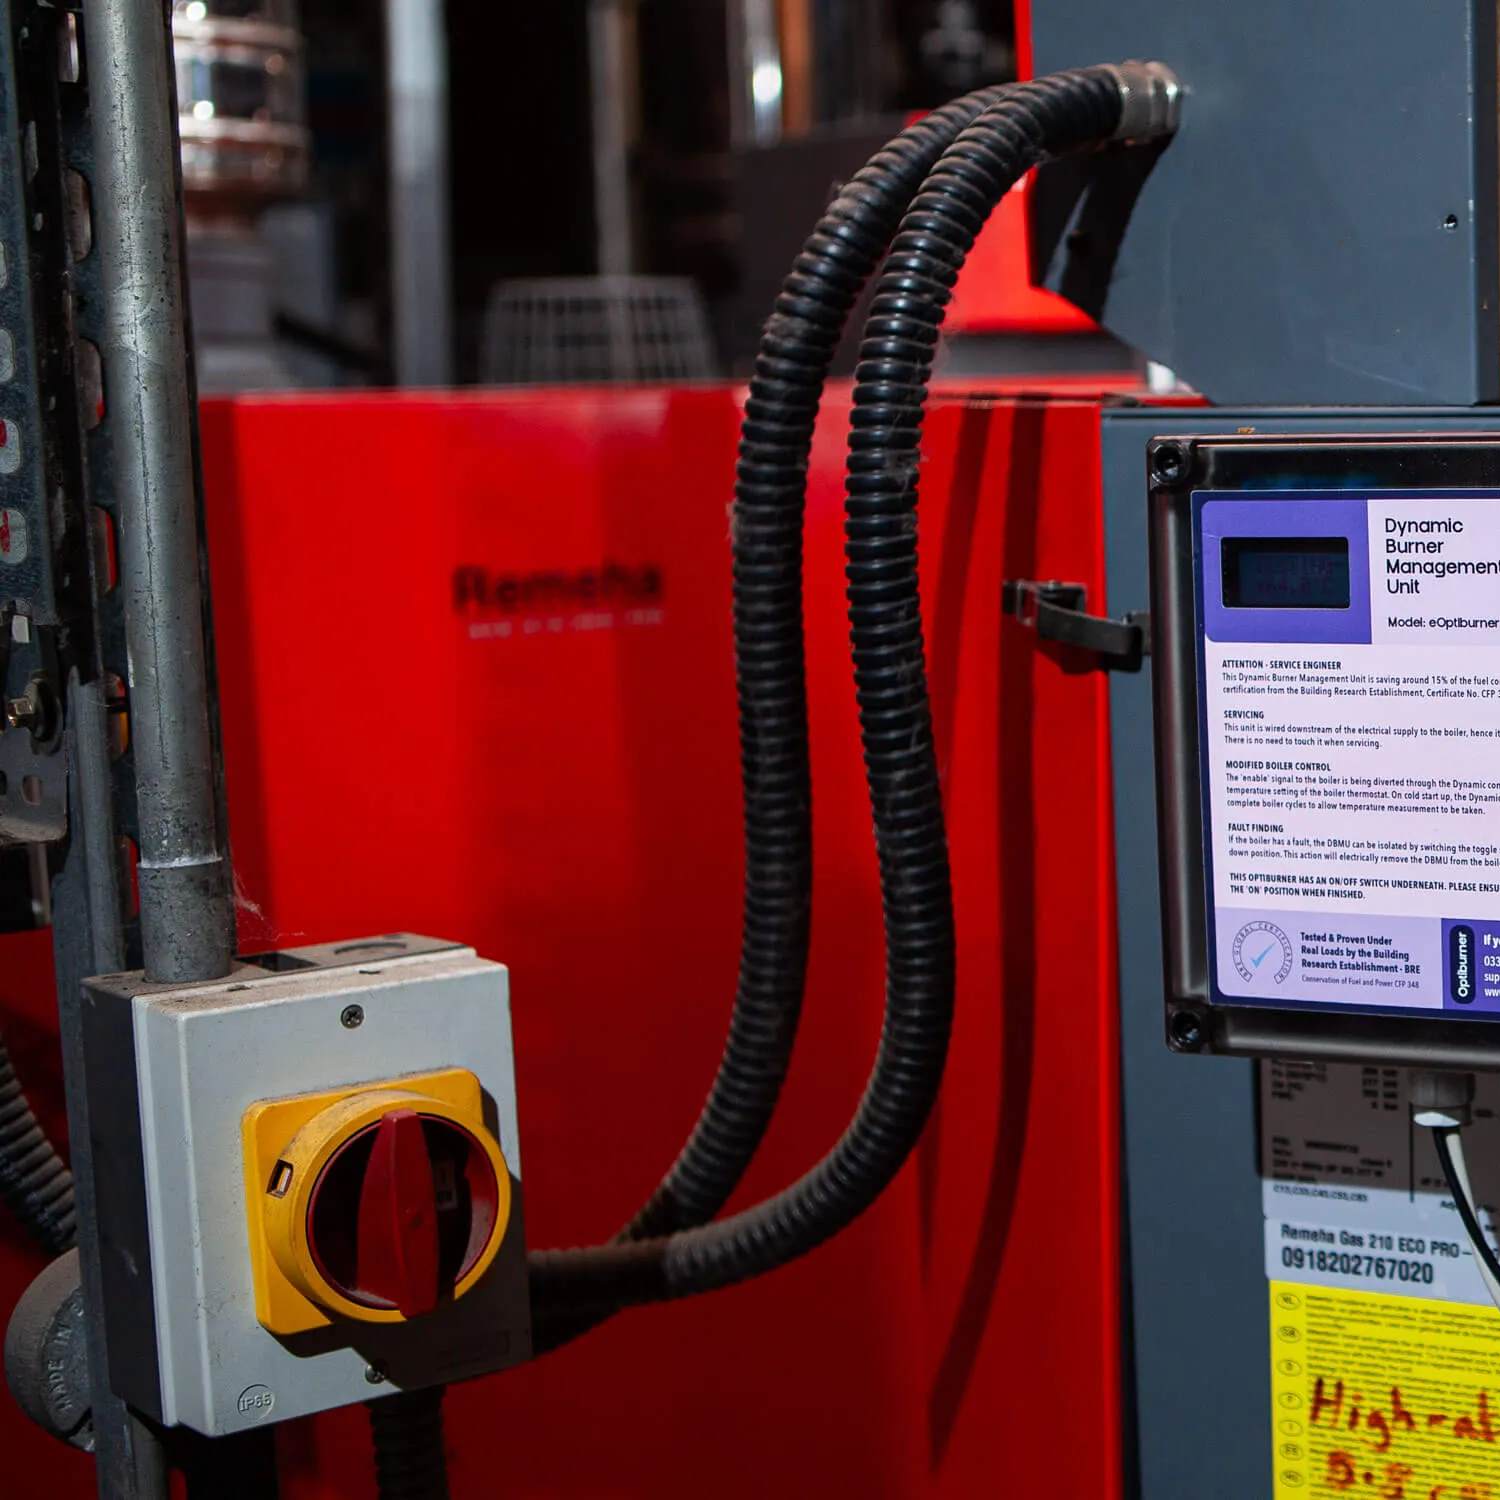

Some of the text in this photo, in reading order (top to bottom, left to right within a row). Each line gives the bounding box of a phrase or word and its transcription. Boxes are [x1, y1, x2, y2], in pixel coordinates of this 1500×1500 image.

[1384, 518, 1463, 537] Dynamic
[1385, 538, 1444, 553] Burner
[1386, 579, 1420, 594] Unit
[1387, 617, 1500, 629] Model: eOptiburner
[1221, 659, 1263, 668] ATTENTION
[1269, 660, 1301, 669] SERVICE
[1302, 661, 1342, 670] ENGINEER
[1222, 672, 1237, 681] This
[1238, 672, 1270, 683] Dynamic
[1272, 673, 1297, 682] Burner
[1298, 673, 1348, 684] Management
[1350, 674, 1366, 683] Unit
[1367, 675, 1374, 683] is
[1375, 677, 1400, 686] saving
[1402, 675, 1429, 684] around
[1431, 675, 1448, 684] 15%
[1449, 675, 1458, 685] of
[1458, 676, 1472, 685] the
[1473, 675, 1489, 685] fuel
[1222, 684, 1266, 693] certification
[1266, 685, 1285, 694] from
[1286, 686, 1299, 694] the
[1300, 686, 1332, 697] Building
[1334, 686, 1367, 695] Research
[1368, 687, 1425, 697] Establishment,
[1426, 688, 1464, 697] Certificate
[1466, 689, 1480, 698] No.
[1481, 689, 1496, 698] CFP
[1223, 710, 1264, 719] SERVICING
[1224, 722, 1239, 731] This
[1256, 724, 1263, 732] is
[1264, 724, 1286, 732] wired
[1286, 724, 1332, 733] downstream
[1334, 724, 1342, 733] of
[1343, 725, 1356, 734] the
[1357, 726, 1391, 734] electrical
[1392, 727, 1418, 737] supply
[1420, 727, 1428, 736] to
[1429, 727, 1442, 736] the
[1443, 727, 1468, 737] boiler,
[1470, 728, 1493, 737] hence
[1494, 728, 1500, 737] it
[1224, 735, 1245, 744] There
[1246, 735, 1253, 744] is
[1265, 736, 1284, 745] need
[1284, 737, 1293, 745] to
[1294, 737, 1315, 745] touch
[1316, 738, 1322, 746] it
[1323, 737, 1344, 746] when
[1346, 738, 1382, 749] servicing.
[1225, 760, 1331, 771] MODIFIED BOILER CONTROL
[1228, 823, 1284, 832] FAULT FINDING
[1229, 872, 1246, 881] THIS
[1248, 873, 1297, 883] OPTIBURNER
[1298, 876, 1314, 884] HAS
[1315, 876, 1327, 884] AN
[1328, 877, 1358, 886] ON/OFF
[1359, 878, 1390, 887] SWITCH
[1391, 880, 1446, 890] UNDERNEATH.
[1448, 882, 1477, 891] PLEASE
[1230, 884, 1244, 893] THE
[1263, 886, 1300, 896] POSITION
[1301, 888, 1326, 897] WHEN
[1327, 889, 1366, 899] FINISHED.
[1300, 931, 1392, 945] Tested & Proven Under
[1483, 934, 1491, 945] If
[1300, 945, 1410, 962] Real Loads by the Building
[1301, 958, 1338, 969] Research
[1339, 961, 1398, 972] Establishment
[1404, 964, 1420, 974] BRE
[1458, 931, 1469, 997] Optiburner
[1281, 1223, 1335, 1244] Remeha
[1340, 1230, 1364, 1248] Gas
[1369, 1234, 1393, 1251] 210
[1399, 1237, 1426, 1254] ECO
[1281, 1246, 1434, 1284] 0918202767020
[48, 1359, 73, 1411] MADE
[239, 1393, 273, 1412] IP65
